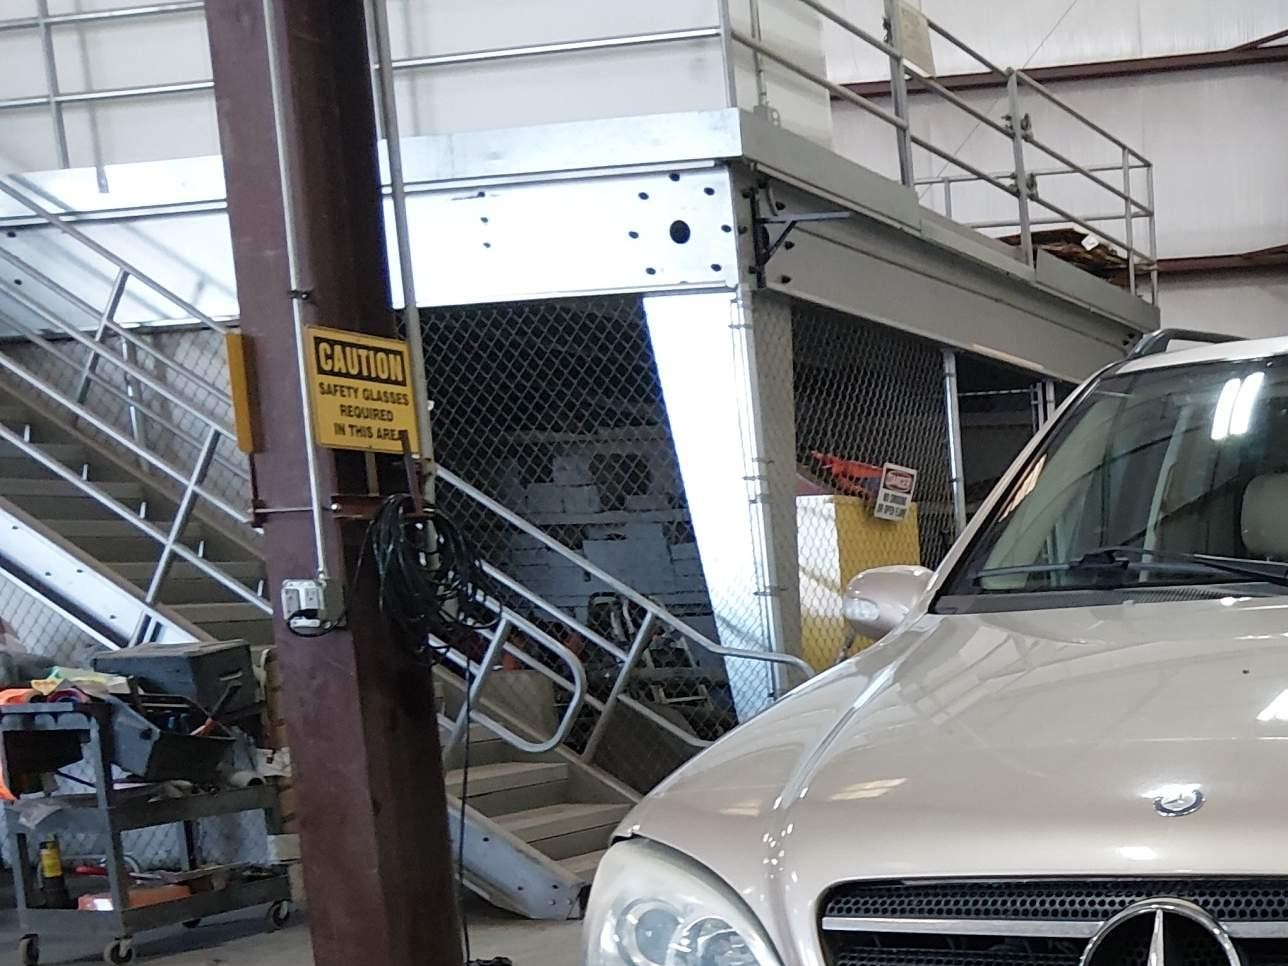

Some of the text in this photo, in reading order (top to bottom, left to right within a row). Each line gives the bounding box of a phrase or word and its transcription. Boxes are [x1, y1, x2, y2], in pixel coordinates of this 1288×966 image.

[318, 342, 403, 381] CAUTION
[319, 382, 409, 405] SAFETY GLASSES
[340, 404, 393, 421] REQUIRED
[334, 423, 345, 436] IN
[348, 425, 373, 439] THIS
